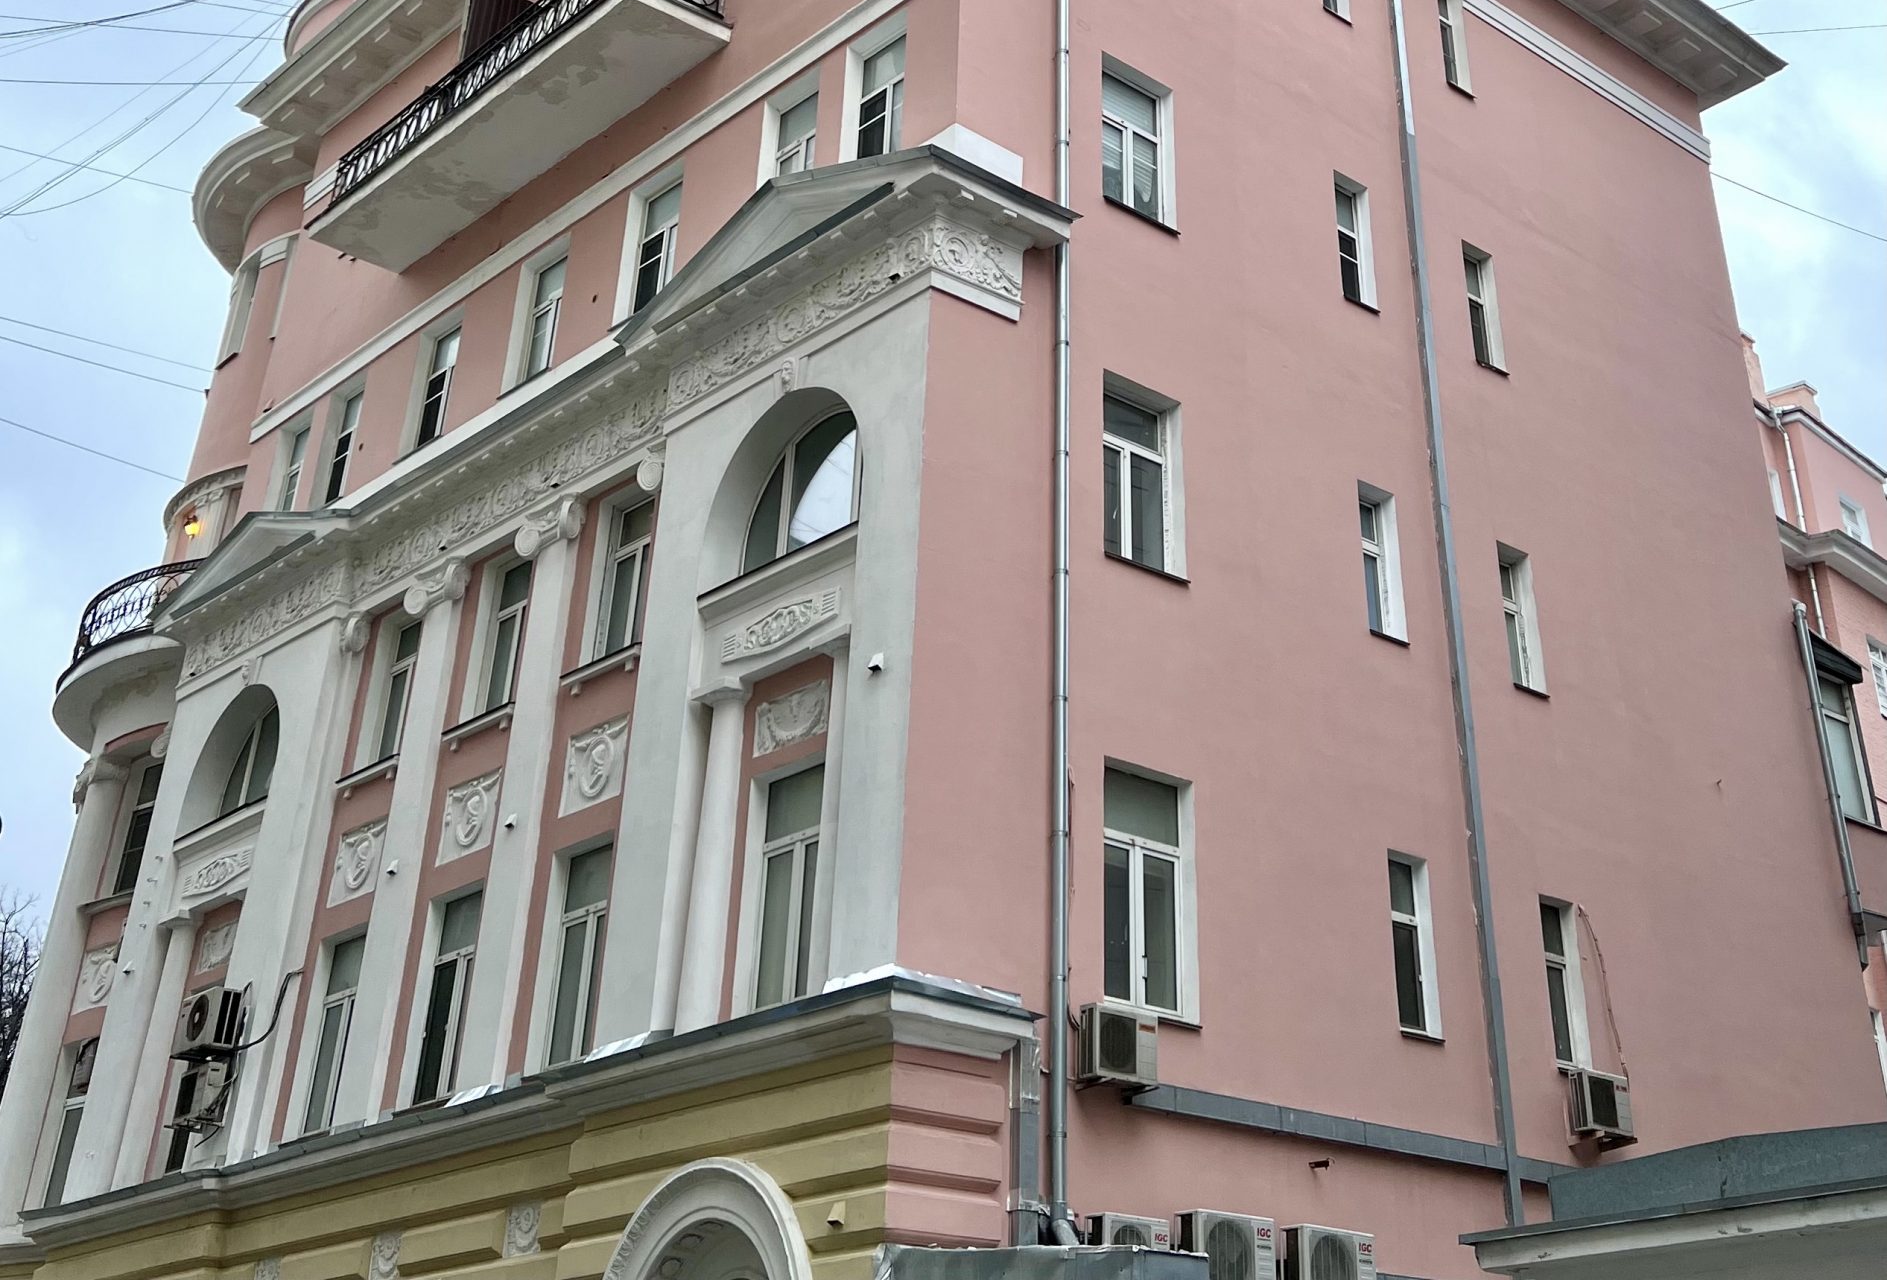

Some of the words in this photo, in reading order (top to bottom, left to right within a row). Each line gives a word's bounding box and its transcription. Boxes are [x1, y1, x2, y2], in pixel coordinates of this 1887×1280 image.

[1155, 1233, 1168, 1242] IGC
[1257, 1228, 1271, 1238] IGC
[1359, 1242, 1372, 1252] IGC
